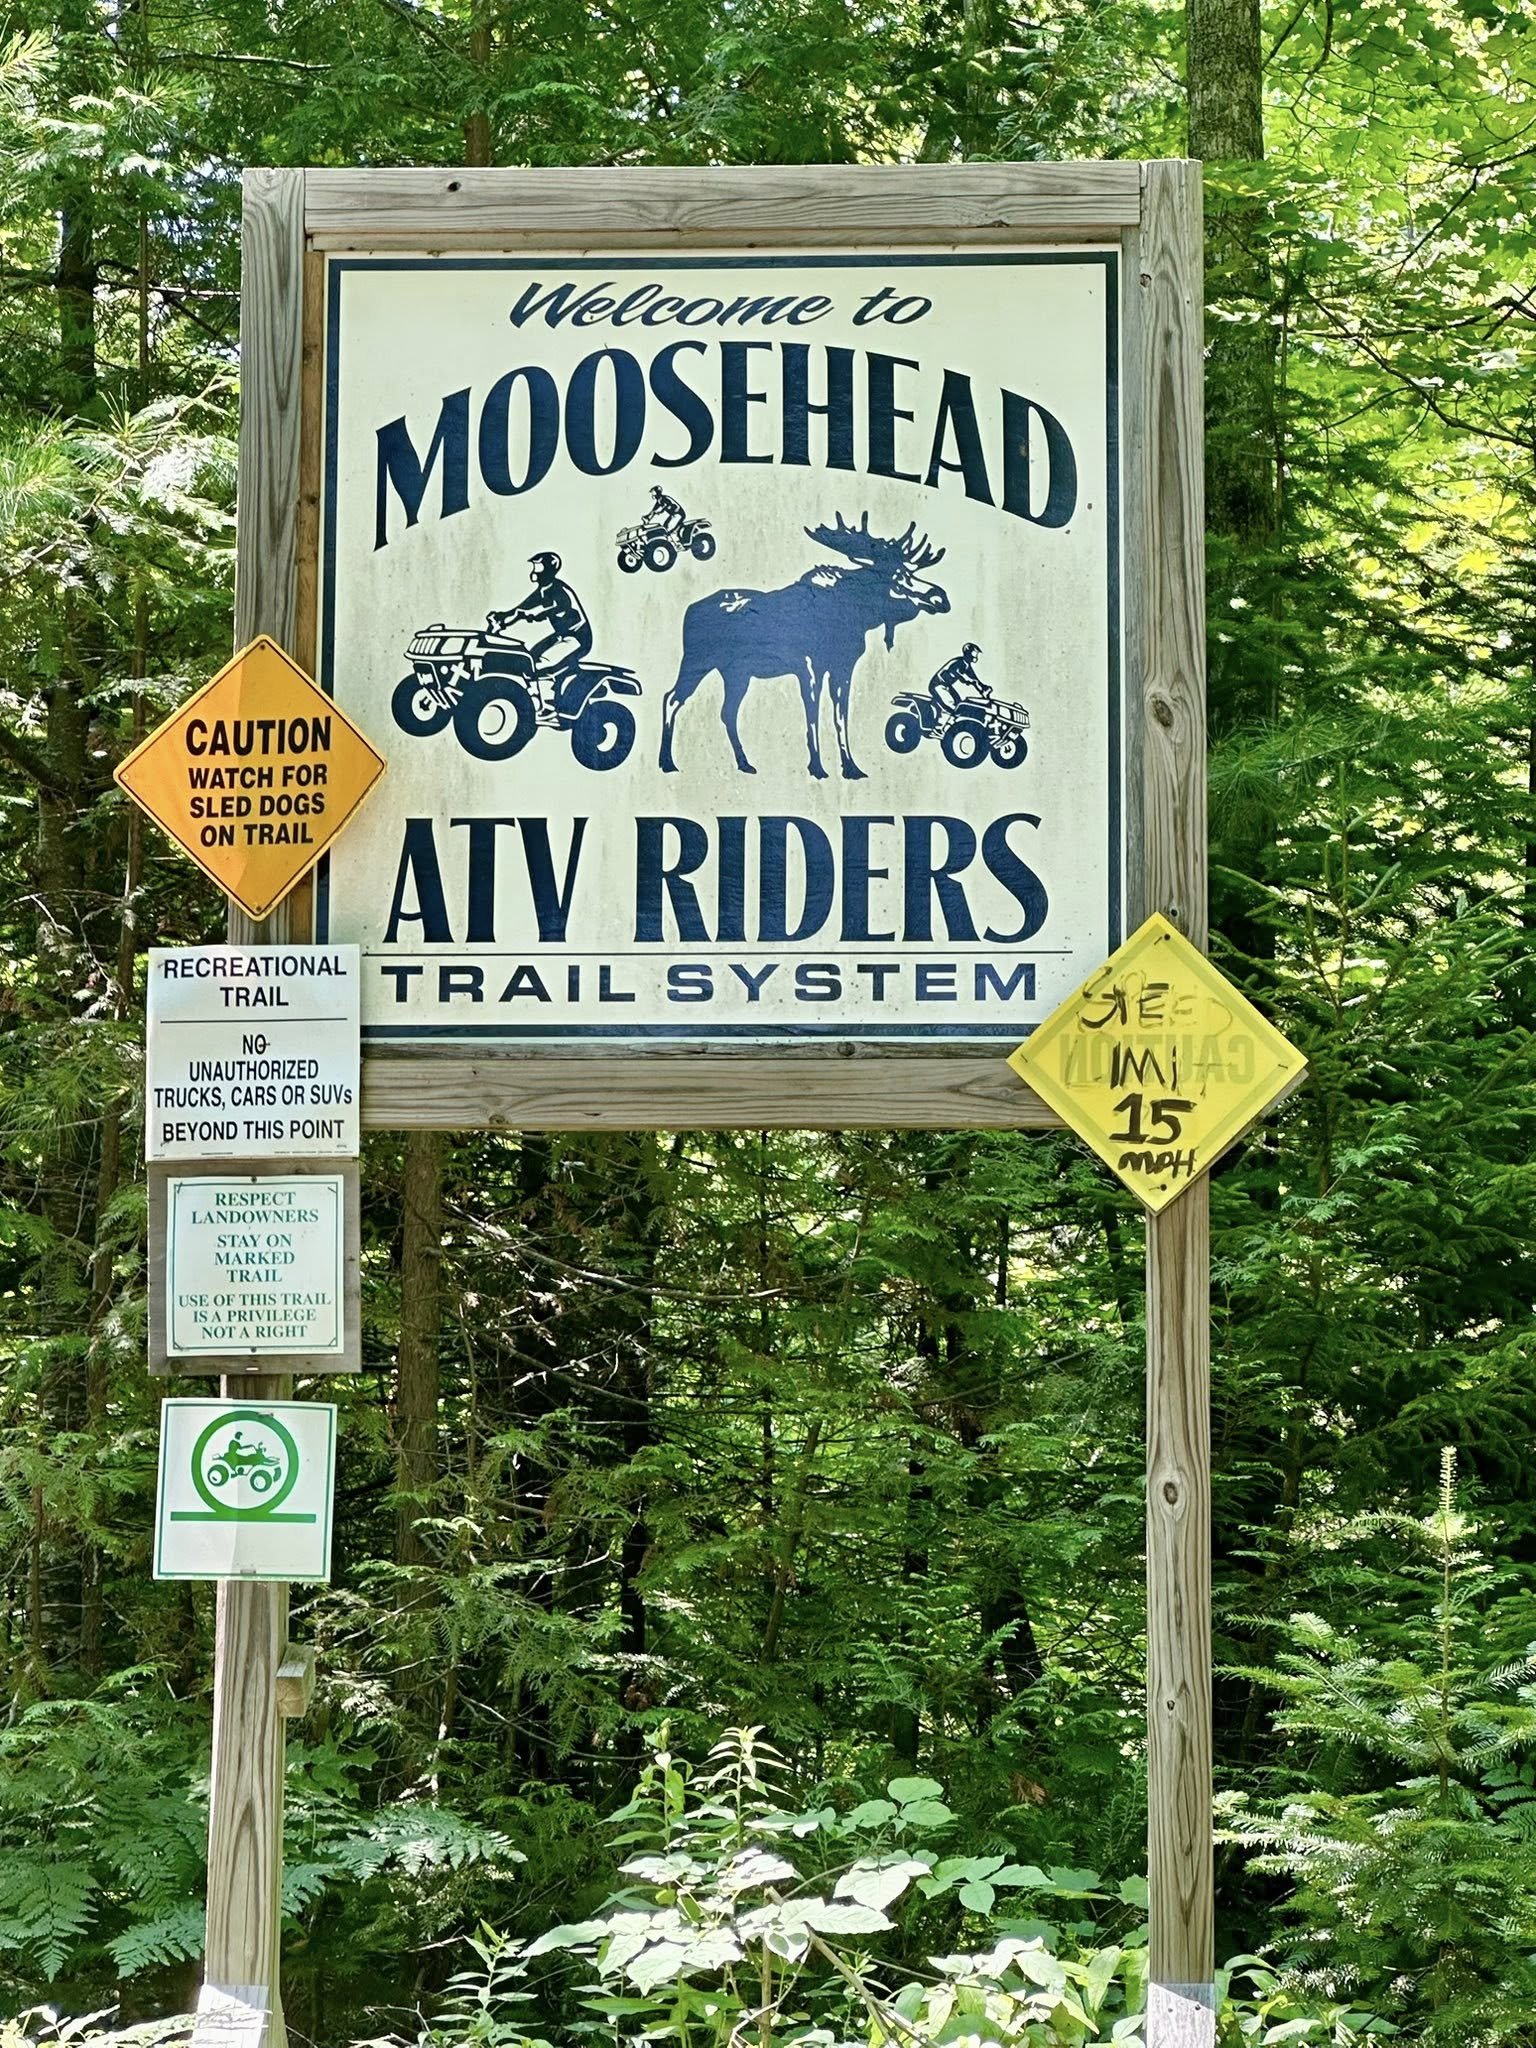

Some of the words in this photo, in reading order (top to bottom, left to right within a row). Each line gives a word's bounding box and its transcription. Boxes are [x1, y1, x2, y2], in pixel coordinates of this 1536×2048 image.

[508, 282, 834, 329] Welcome
[852, 286, 933, 328] to
[373, 340, 1079, 552] MOOSEHEAD
[186, 716, 332, 756] CAUTION
[188, 766, 274, 789] WATCH
[282, 764, 328, 787] FOR
[190, 796, 251, 818] SLED
[259, 792, 326, 816] DOGS
[200, 825, 235, 848] ON
[243, 823, 314, 846] TRAIL
[383, 816, 589, 943] ATV
[634, 814, 1049, 943] RIDERS
[164, 956, 347, 979] RECREATIONAL
[381, 964, 635, 1003] TRAIL
[666, 962, 1037, 1002] SYSTEM
[219, 986, 289, 1007] TRAIL
[242, 1034, 267, 1055] NO
[189, 1059, 319, 1081] UNAUTHORIZED
[154, 1087, 226, 1110] TRUCKS,
[231, 1085, 277, 1106] CARS
[282, 1085, 305, 1105] OR
[310, 1084, 352, 1105] SUVs
[163, 1122, 238, 1141] BEYOND
[243, 1120, 284, 1139] THIS
[290, 1119, 345, 1139] POINT
[1109, 1093, 1198, 1145] 15
[215, 1192, 296, 1206] RESPECT
[191, 1209, 319, 1224] LANDOWNERS
[217, 1234, 260, 1248] STAY
[266, 1233, 292, 1247] ON
[214, 1251, 295, 1266] MARKED
[226, 1269, 282, 1283] TRAIL
[178, 1294, 209, 1307] USE
[213, 1294, 235, 1306] OF
[239, 1293, 276, 1306] THIS
[280, 1292, 331, 1306] TRAIL
[193, 1310, 208, 1323] IS
[211, 1310, 222, 1322] A
[227, 1309, 316, 1322] PRIVILEGE
[201, 1326, 236, 1339] NOT
[240, 1326, 250, 1338] A
[255, 1325, 308, 1338] RIGHT
